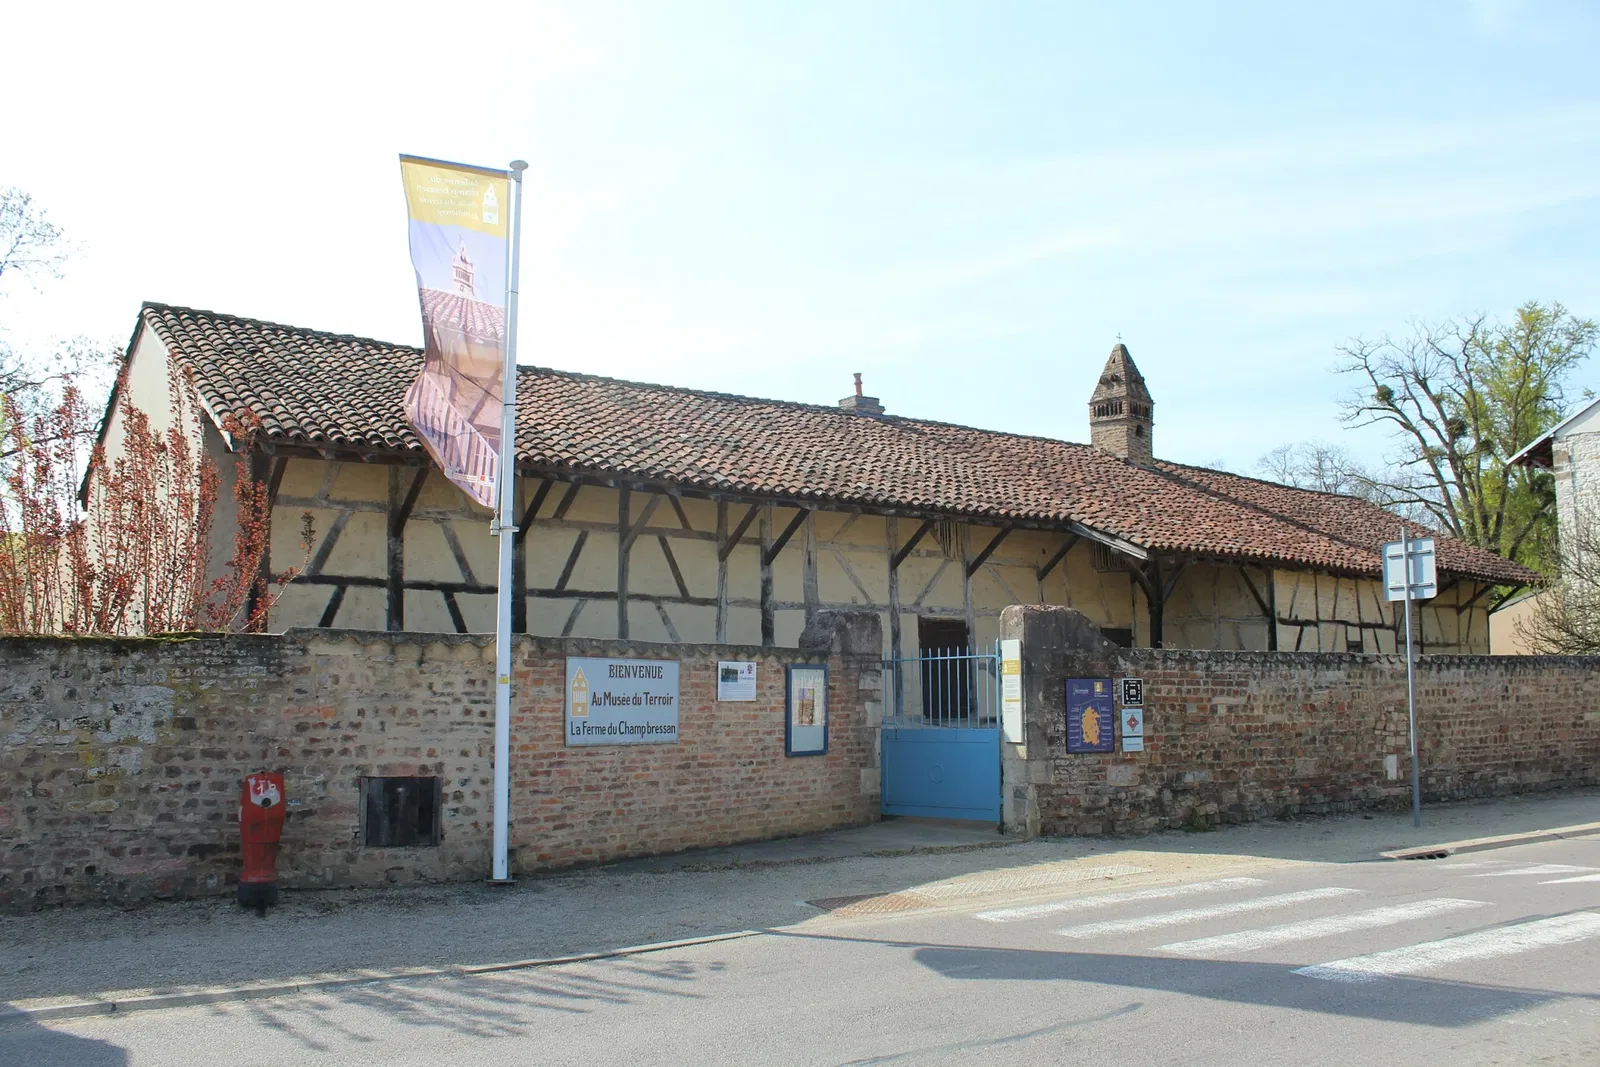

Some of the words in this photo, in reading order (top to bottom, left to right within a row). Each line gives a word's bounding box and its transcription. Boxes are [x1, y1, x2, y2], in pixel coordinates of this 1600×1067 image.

[608, 664, 663, 679] BIENVENUE
[591, 692, 602, 706] Au
[603, 691, 630, 706] Musée
[632, 693, 642, 705] du
[643, 691, 673, 706] Terroir
[570, 721, 580, 735] La
[582, 721, 606, 735] Ferme
[607, 722, 618, 735] du
